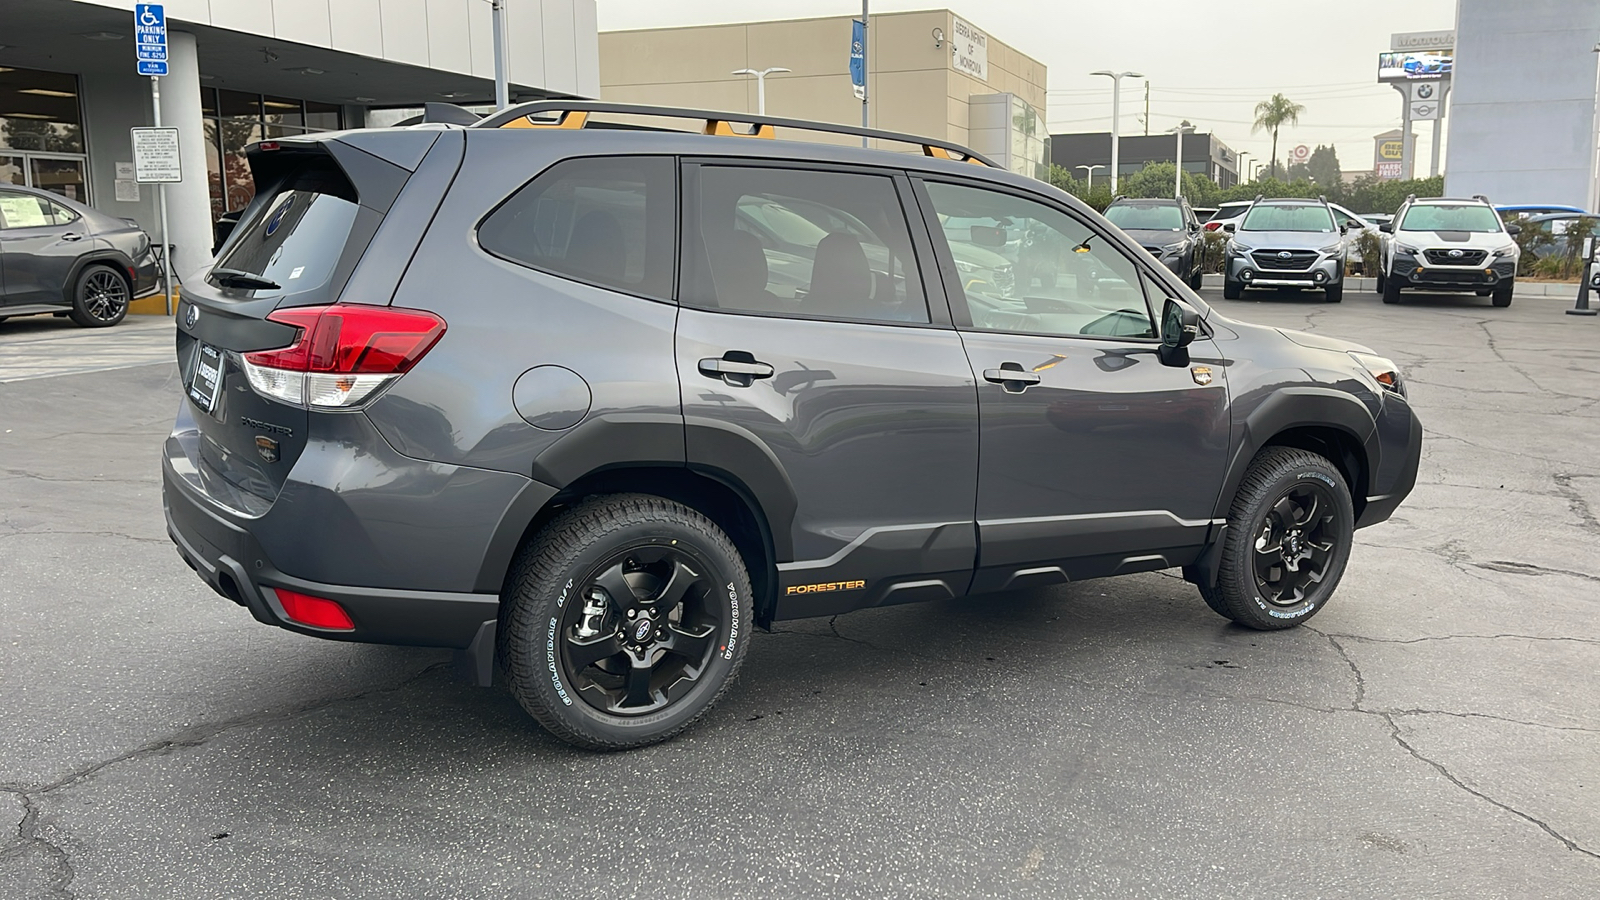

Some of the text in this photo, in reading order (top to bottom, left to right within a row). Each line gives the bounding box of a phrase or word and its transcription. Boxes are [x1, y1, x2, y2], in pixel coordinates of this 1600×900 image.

[137, 25, 165, 35] PARKING
[143, 35, 160, 43] ONLY
[241, 416, 293, 438] FORESTER
[786, 580, 866, 595] FORESTER
[724, 582, 740, 660] YOKOHAMA
[546, 617, 573, 706] GEOLANDAR
